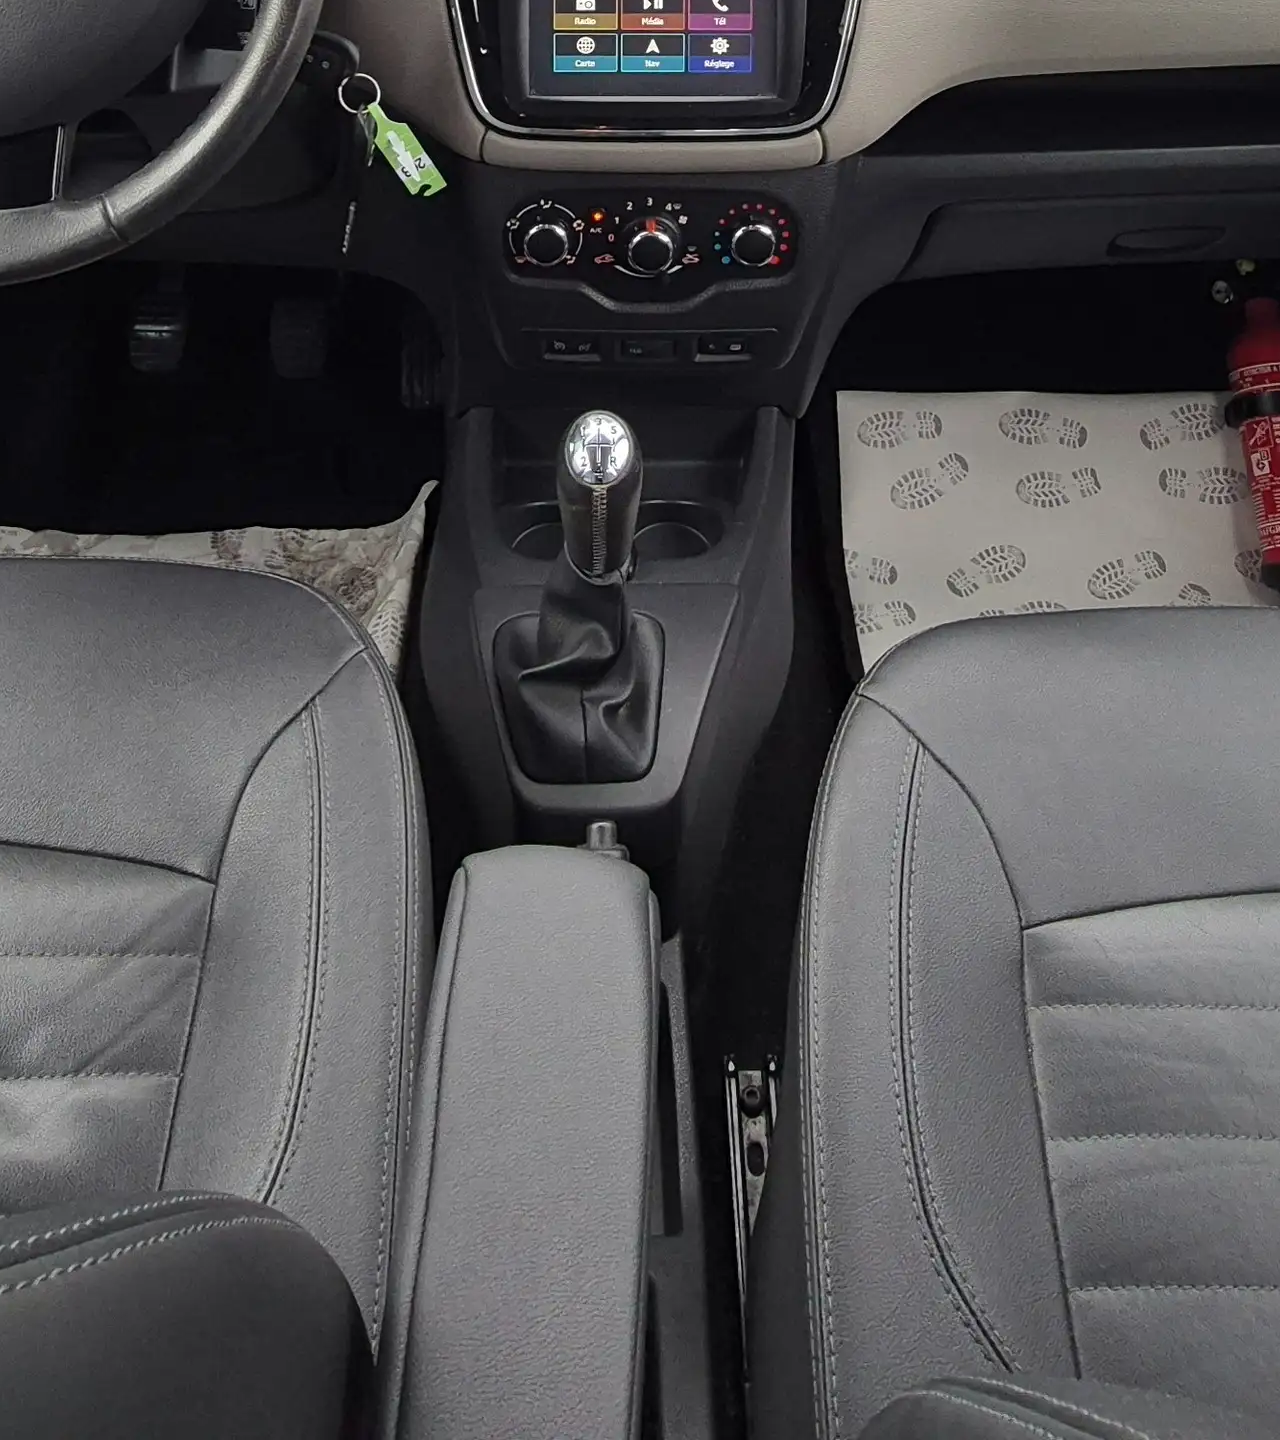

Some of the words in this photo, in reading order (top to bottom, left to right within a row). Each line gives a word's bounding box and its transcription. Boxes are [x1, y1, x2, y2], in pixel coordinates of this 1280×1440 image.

[574, 17, 597, 26] Radio
[713, 16, 727, 26] Tél
[644, 59, 661, 68] Nav
[626, 201, 633, 211] 2
[646, 197, 653, 206] 3
[665, 202, 672, 211] 4
[614, 216, 620, 225] 1
[608, 233, 615, 242] 0
[595, 417, 602, 425] 3
[610, 425, 617, 435] 5
[580, 456, 587, 467] 2
[610, 456, 618, 467] R
